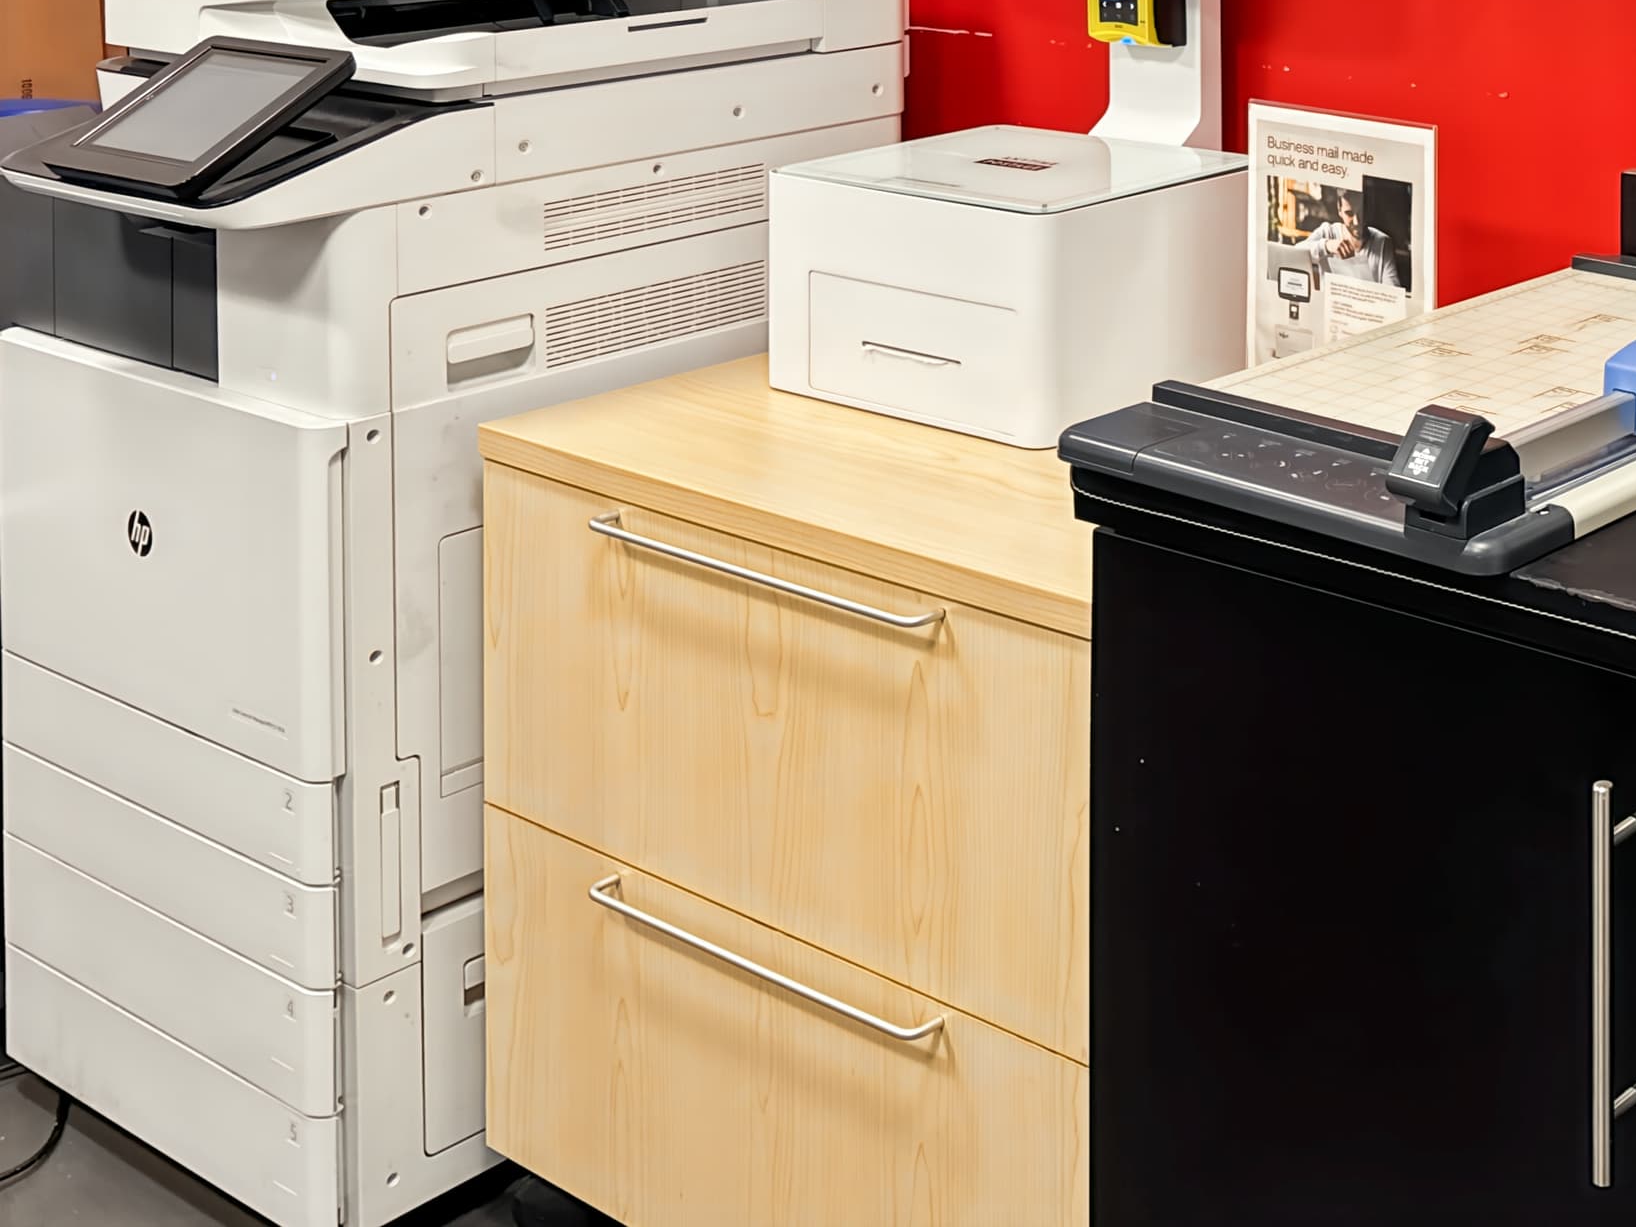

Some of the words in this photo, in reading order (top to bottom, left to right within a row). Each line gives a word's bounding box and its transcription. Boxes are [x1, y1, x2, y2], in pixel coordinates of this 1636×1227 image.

[1267, 135, 1314, 155] Business
[1317, 145, 1339, 159] mail
[1342, 150, 1374, 165] made
[1267, 154, 1296, 168] quick
[1298, 158, 1319, 172] and
[1321, 162, 1349, 178] easy.
[128, 509, 153, 558] hp
[285, 792, 293, 811] 2
[287, 895, 294, 914] 3
[290, 1123, 297, 1141] 5
